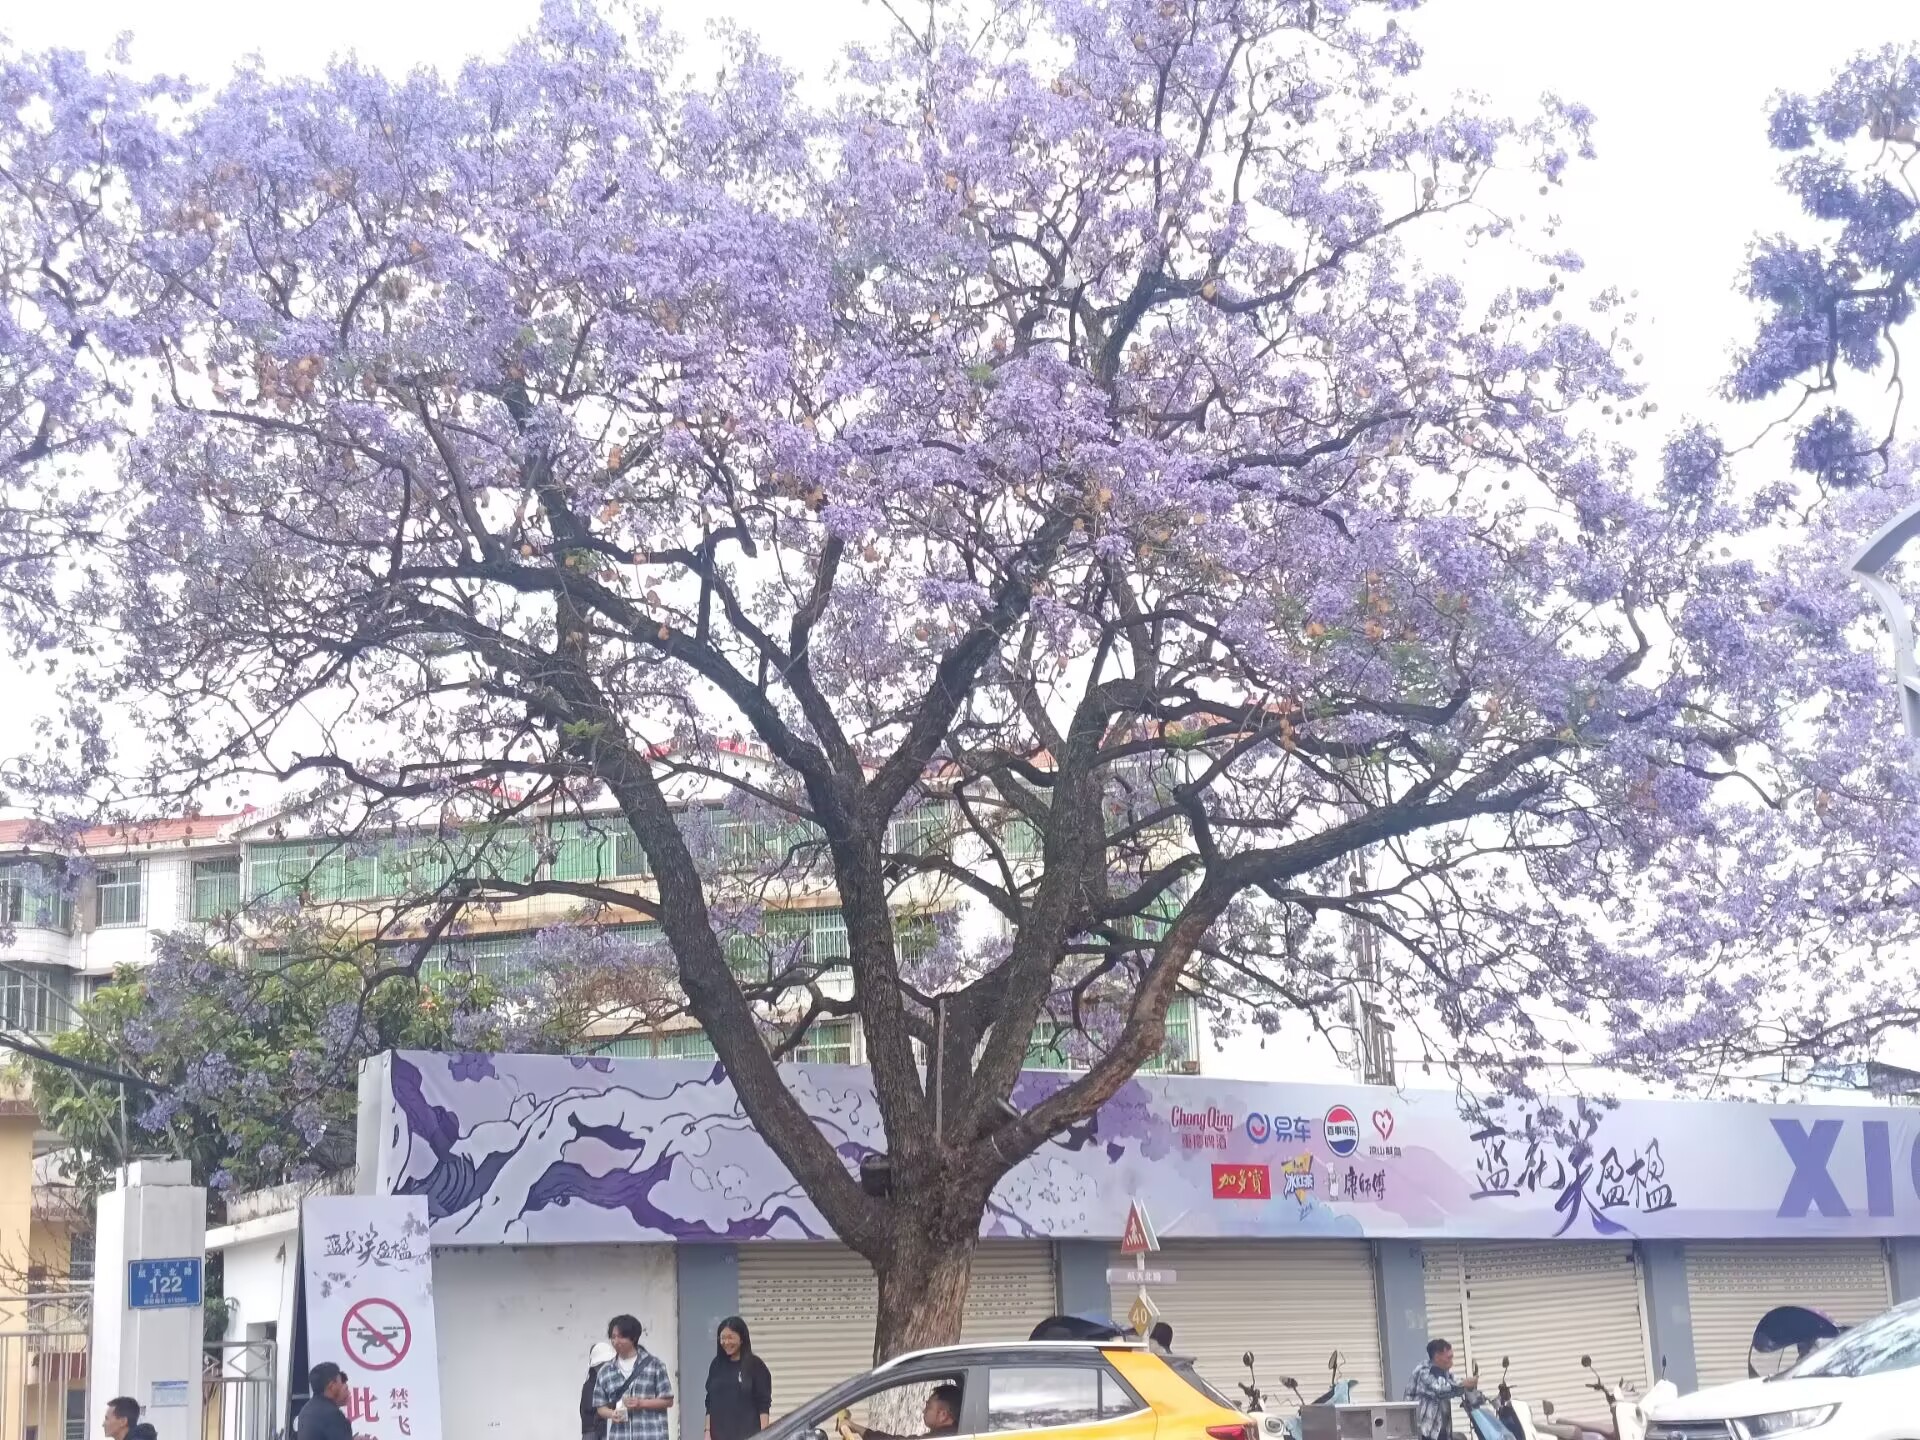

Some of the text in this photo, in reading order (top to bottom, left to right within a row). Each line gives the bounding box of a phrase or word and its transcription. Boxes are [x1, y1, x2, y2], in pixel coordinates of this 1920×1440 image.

[1171, 1105, 1233, 1131] ChongQing
[1274, 1116, 1312, 1143] 易车
[1327, 1125, 1357, 1136] 百事可乐
[149, 1276, 182, 1293] 122
[1132, 1309, 1148, 1322] 40
